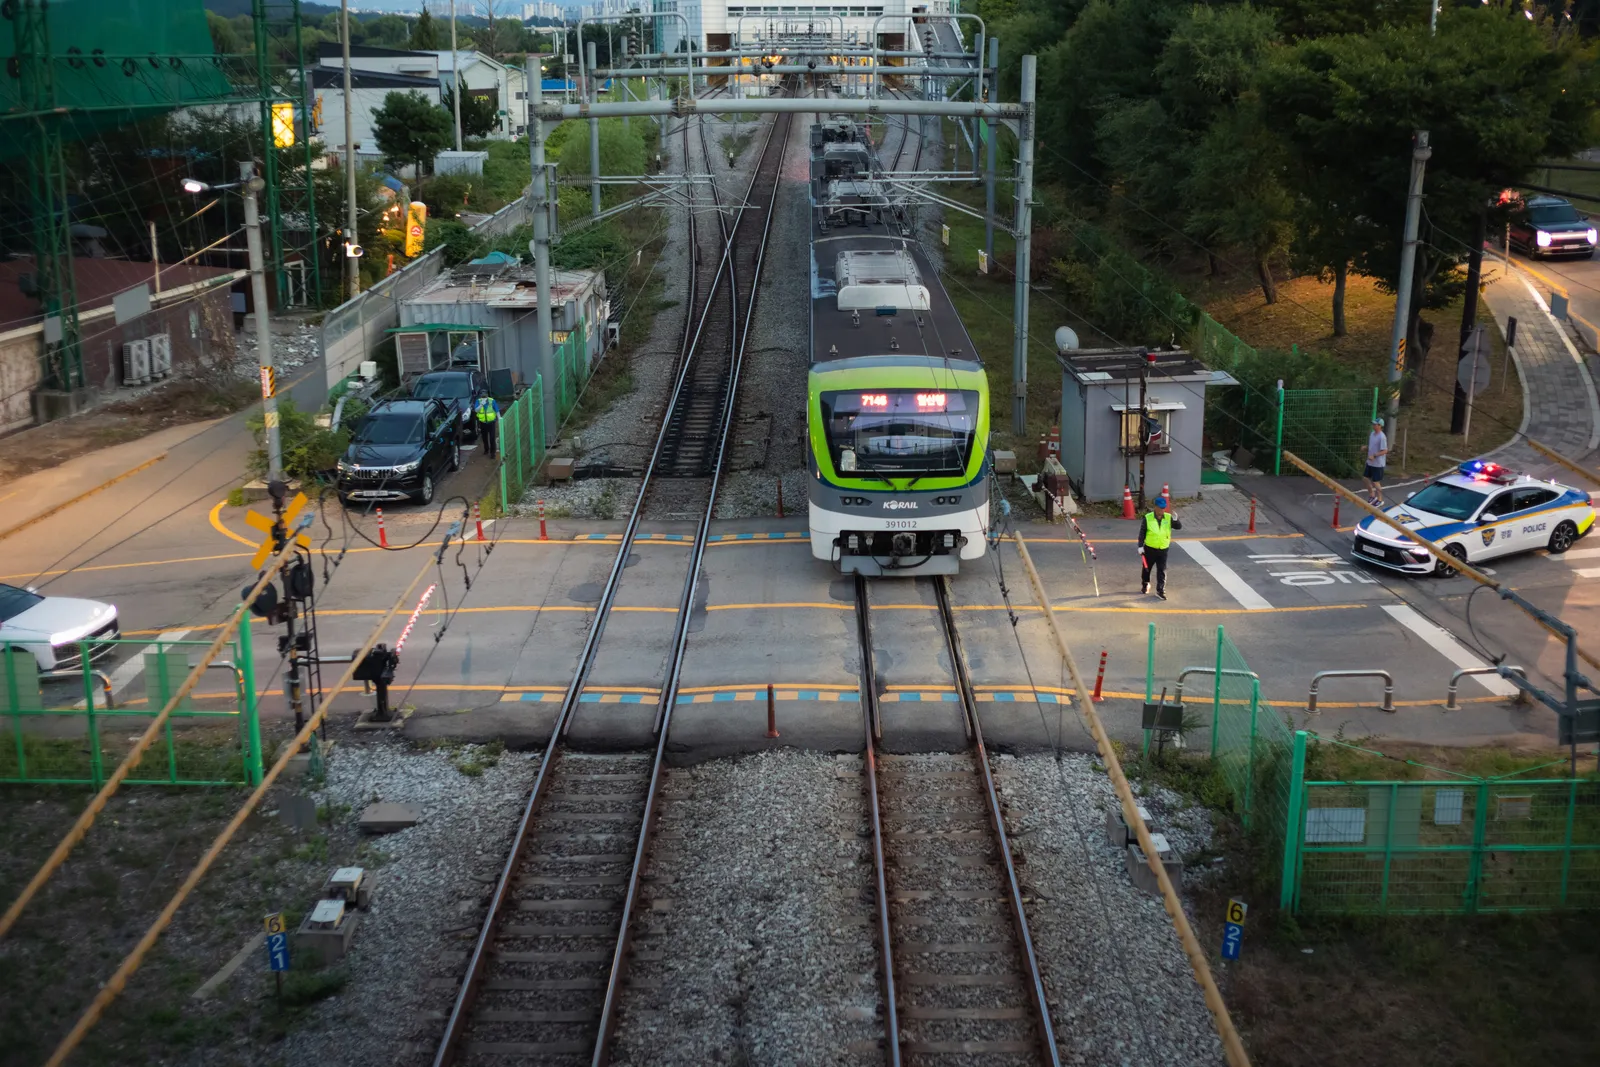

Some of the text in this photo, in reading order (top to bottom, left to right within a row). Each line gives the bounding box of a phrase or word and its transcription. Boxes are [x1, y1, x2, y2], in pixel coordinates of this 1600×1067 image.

[883, 500, 918, 509] KORAIL
[885, 520, 917, 529] 391012
[1522, 522, 1547, 534] POLICE
[1230, 902, 1243, 922] 6
[268, 916, 281, 933] 6
